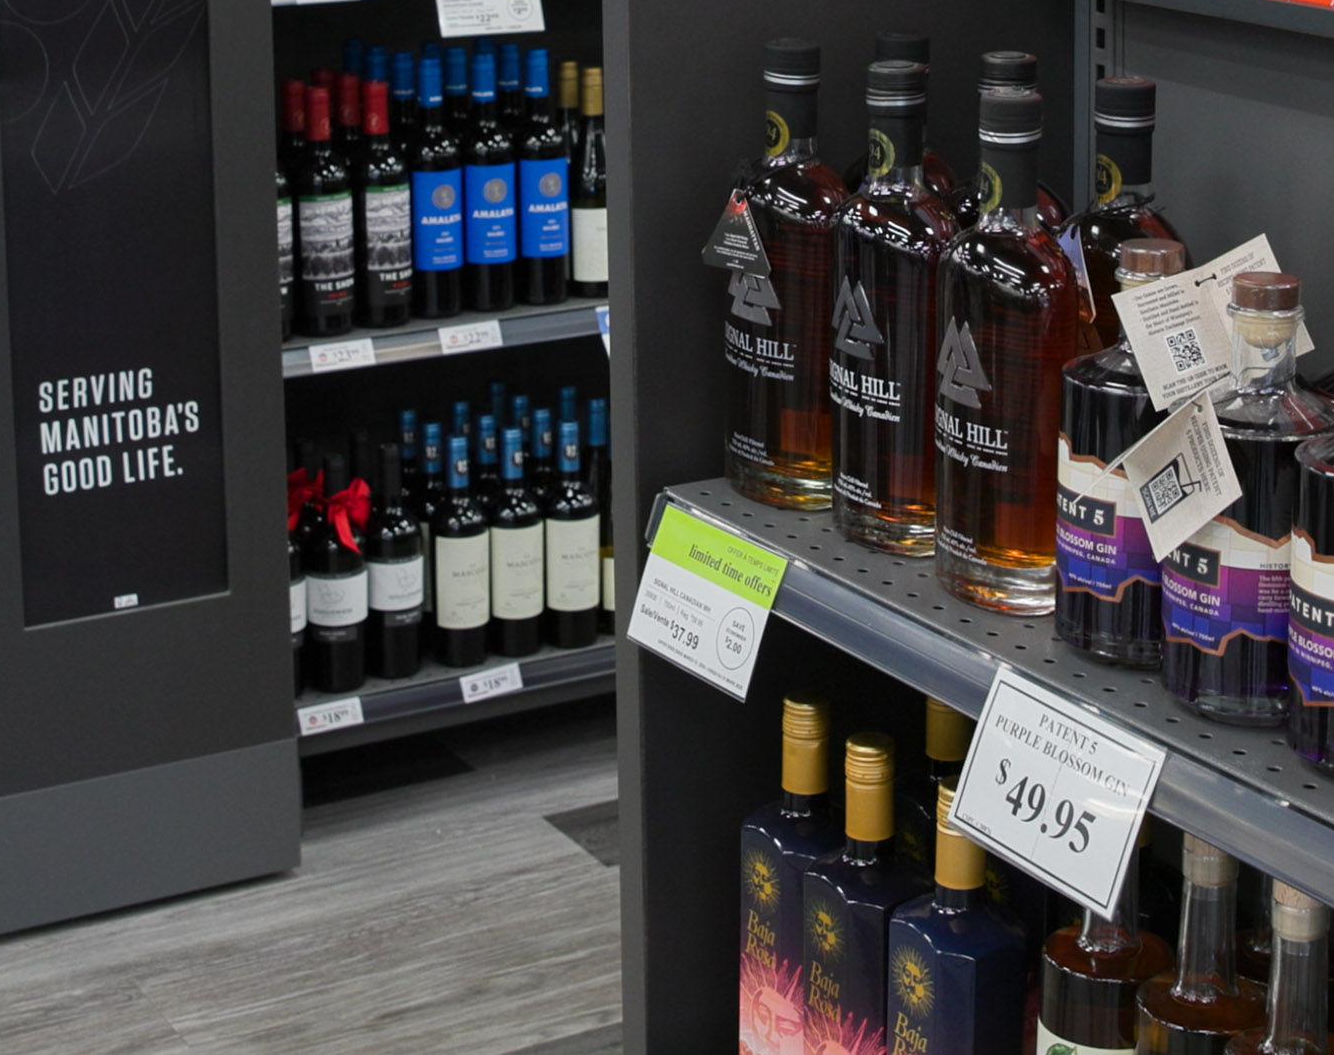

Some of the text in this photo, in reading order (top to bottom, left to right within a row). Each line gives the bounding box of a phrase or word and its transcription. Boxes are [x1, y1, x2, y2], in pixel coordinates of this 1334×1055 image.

[315, 282, 333, 291] THE
[379, 272, 397, 281] THE
[756, 338, 794, 361] HILL
[39, 367, 153, 413] SERVING
[860, 375, 901, 401] HILL
[40, 401, 200, 454] MANITOBA'S
[967, 421, 1008, 449] HILL
[43, 445, 184, 496] GOOD LIFE.
[1093, 508, 1105, 526] 5
[1087, 553, 1115, 565] CANADA
[1096, 543, 1117, 556] GIN
[688, 544, 772, 598] limited time offers
[1197, 558, 1209, 575] 5
[1190, 603, 1219, 617] CANADA
[1199, 592, 1220, 607] GIN
[670, 620, 699, 650] $37.99
[732, 620, 746, 632] SAVE
[725, 636, 742, 655] $2.00
[1038, 713, 1099, 755] PATENT 5
[995, 714, 1131, 798] PURPLE BLOSSOM GIN
[747, 909, 775, 947] Baja
[746, 932, 776, 970] Rosa
[810, 960, 840, 998] Baja
[808, 984, 841, 1023] Rosa
[894, 1011, 928, 1054] Baja
